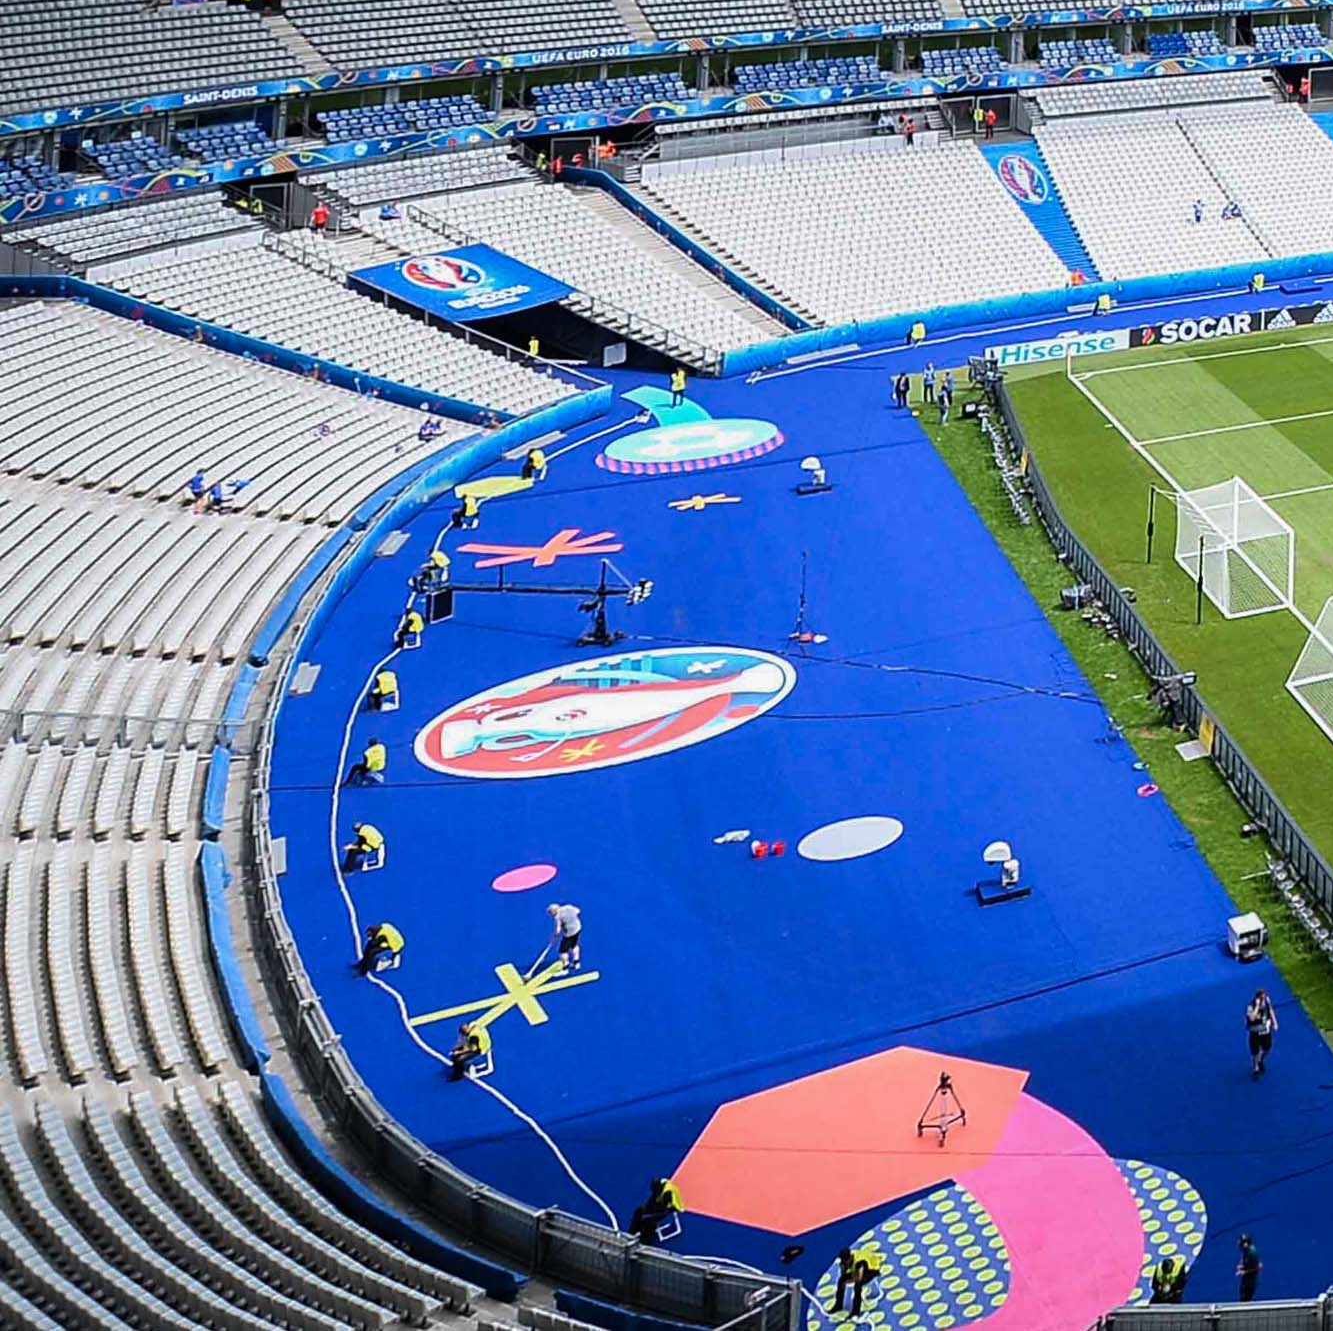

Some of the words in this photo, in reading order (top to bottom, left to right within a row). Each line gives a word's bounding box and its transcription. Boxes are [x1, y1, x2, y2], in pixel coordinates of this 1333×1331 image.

[1167, 4, 1193, 14] UEFA
[1195, 3, 1219, 13] EURO
[1221, 1, 1245, 11] 2016
[881, 22, 944, 34] SAINT-DENIS
[532, 52, 565, 63] UEFA
[566, 49, 598, 61] EURO
[599, 46, 630, 58] 2016
[183, 86, 259, 105] SAINT-DENIS
[1161, 314, 1251, 345] SOCAR
[1001, 334, 1116, 366] Hisense
